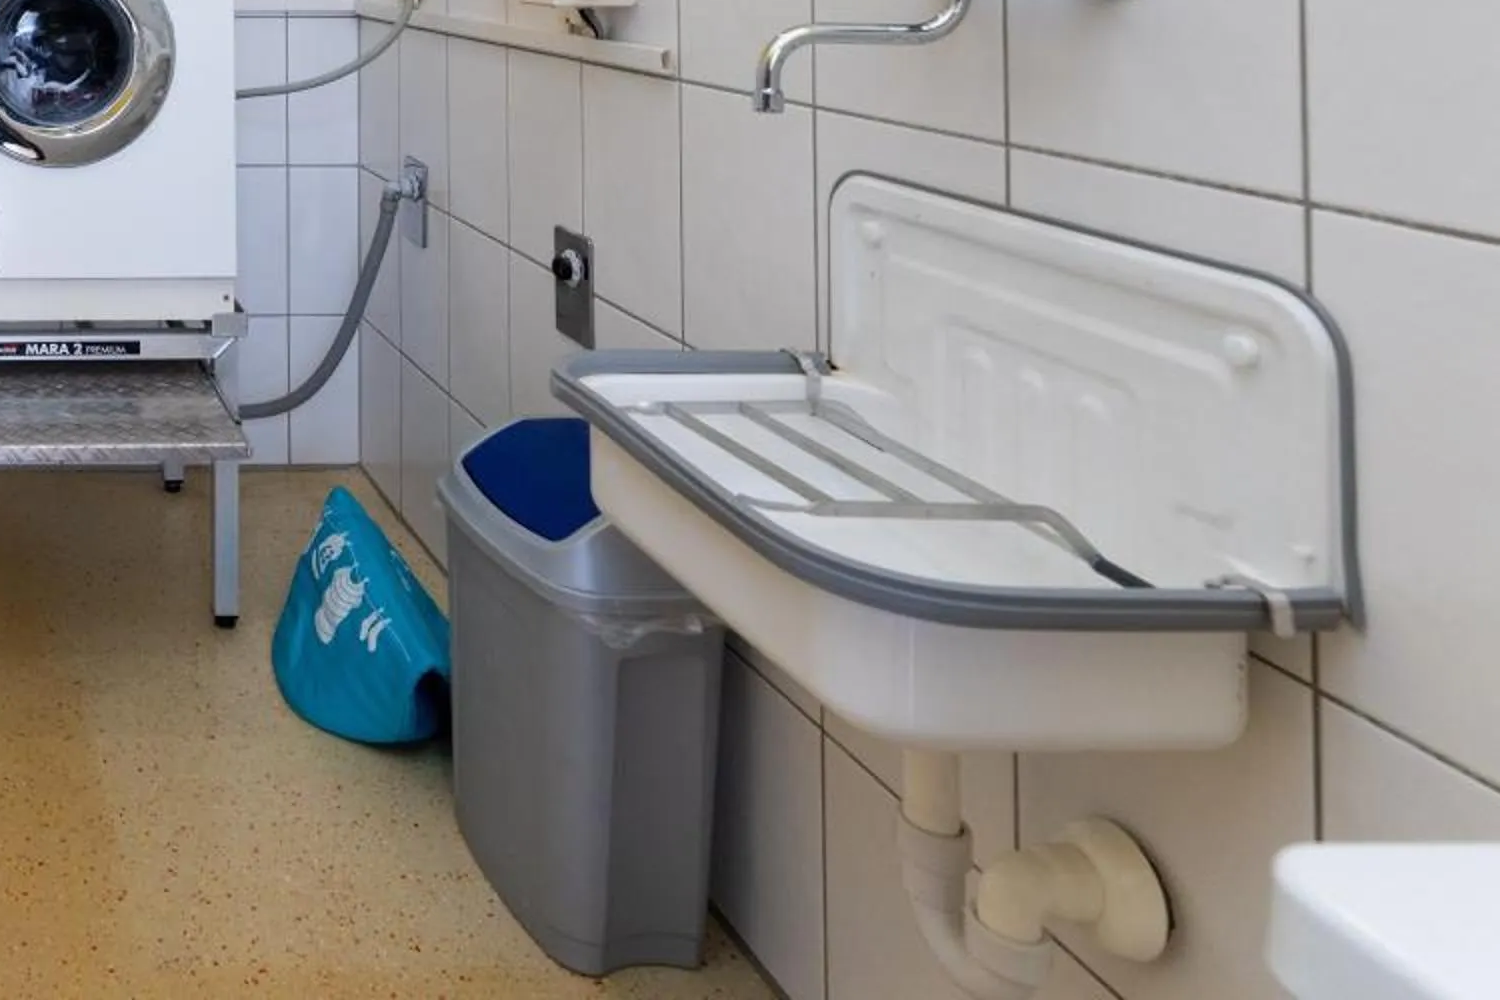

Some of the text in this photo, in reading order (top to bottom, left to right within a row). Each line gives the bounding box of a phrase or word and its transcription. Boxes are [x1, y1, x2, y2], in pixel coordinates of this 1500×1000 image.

[25, 343, 70, 356] MARA
[73, 343, 83, 356] 2
[85, 346, 126, 355] PREMIUM
